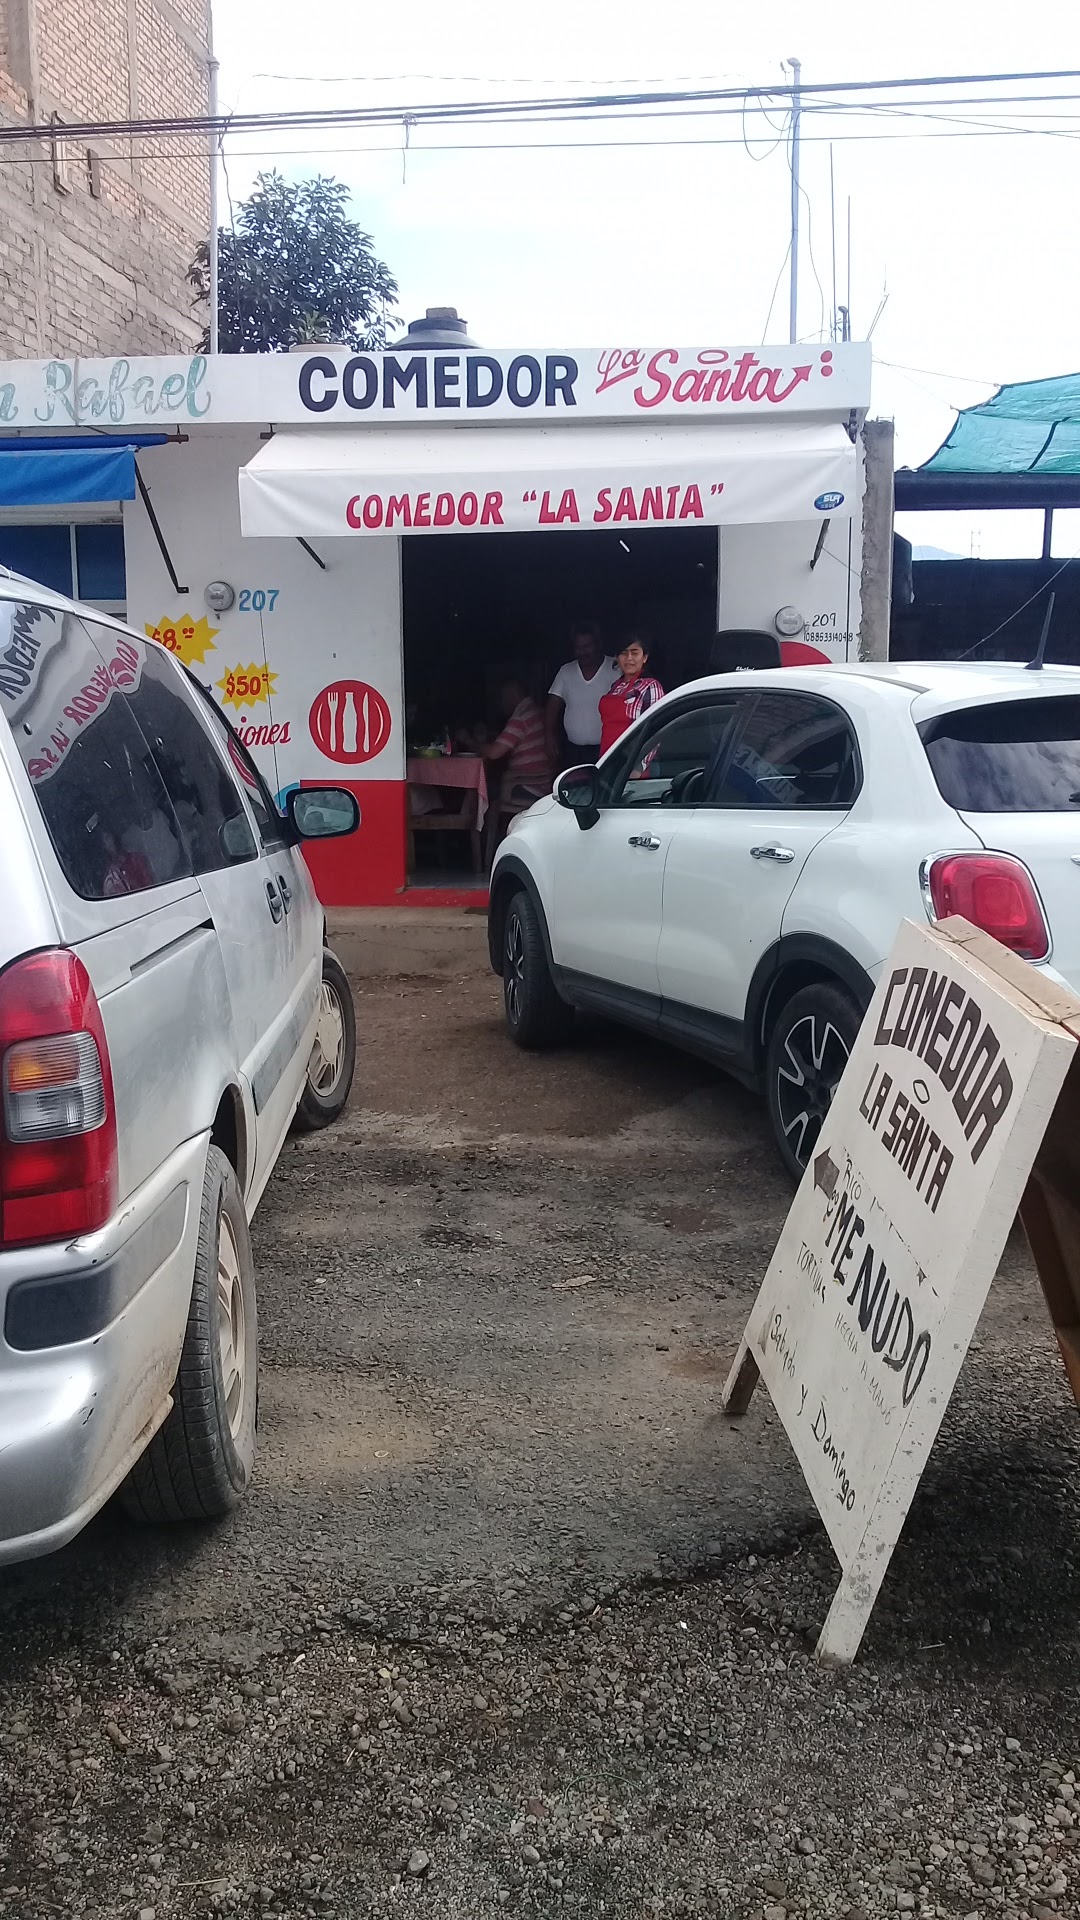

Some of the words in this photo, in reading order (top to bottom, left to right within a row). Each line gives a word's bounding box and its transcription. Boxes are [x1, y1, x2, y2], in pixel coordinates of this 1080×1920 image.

[34, 354, 211, 424] Rafael
[299, 354, 579, 413] COMEDOR
[596, 347, 645, 394] La
[633, 348, 810, 408] Santa
[345, 490, 504, 530] COMEDOR
[239, 590, 280, 611] 207
[812, 612, 836, 627] 209
[874, 966, 1014, 1166] COMEDOR
[858, 1062, 893, 1132] LA
[881, 1090, 955, 1215] SANTA
[824, 1190, 931, 1408] MENUDO
[810, 1400, 856, 1511] Domingo
